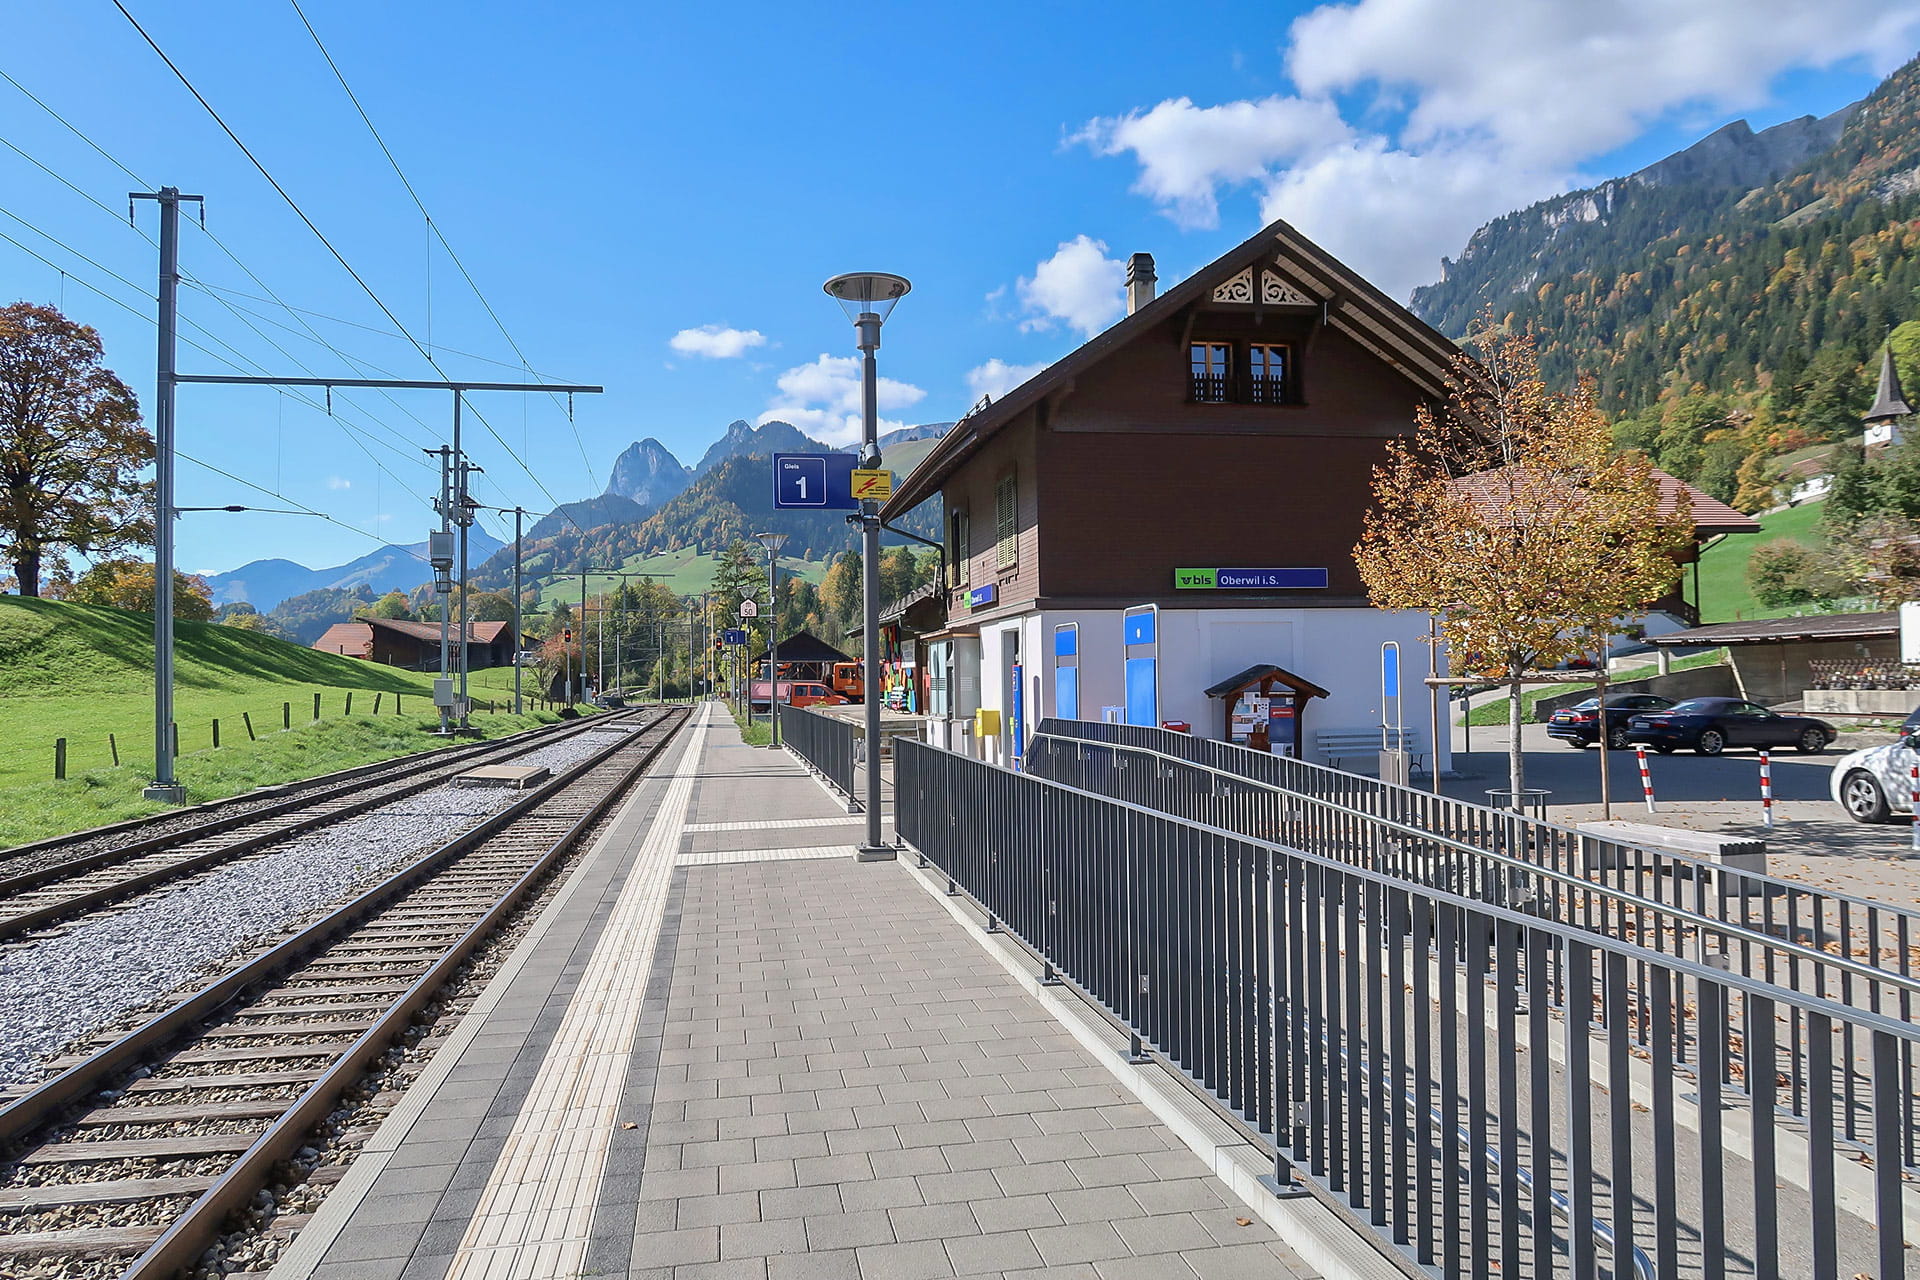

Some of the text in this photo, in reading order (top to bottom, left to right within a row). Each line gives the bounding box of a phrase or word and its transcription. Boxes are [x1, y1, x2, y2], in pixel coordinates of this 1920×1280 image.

[795, 476, 807, 499] 1
[1193, 574, 1280, 585] bls Oberwil i.S.
